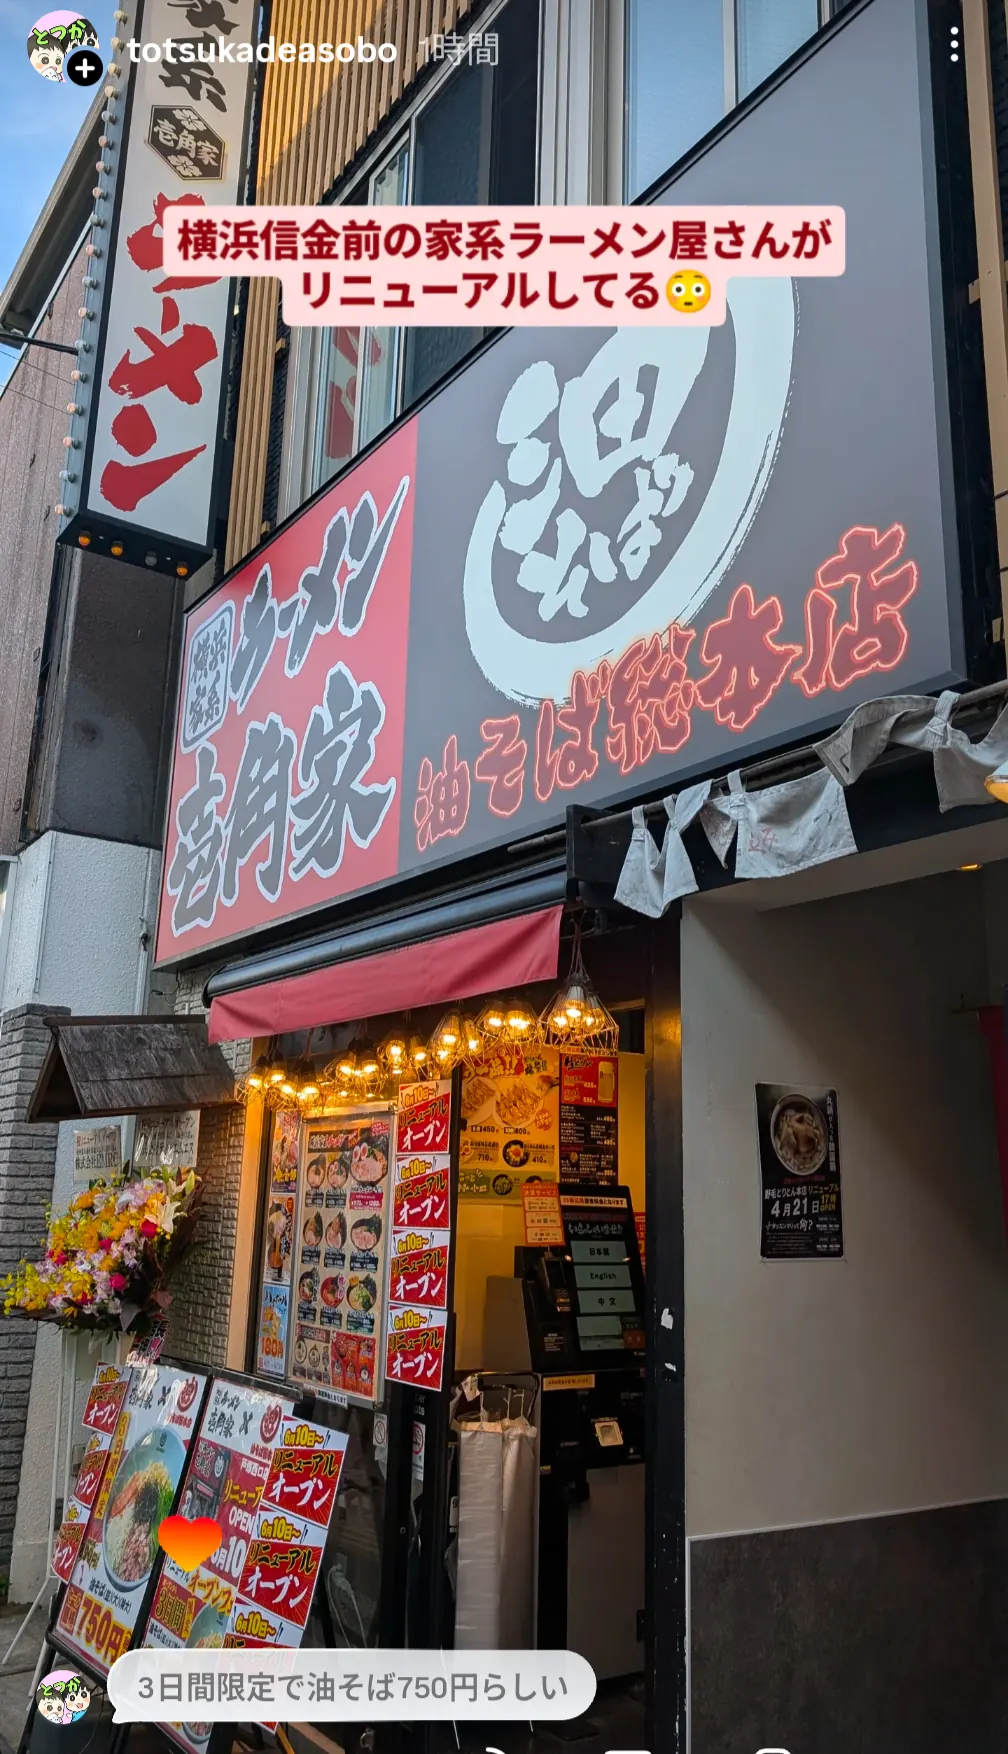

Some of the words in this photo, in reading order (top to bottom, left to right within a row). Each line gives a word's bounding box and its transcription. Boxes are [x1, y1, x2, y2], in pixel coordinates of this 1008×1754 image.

[153, 118, 220, 167] 壱角家
[229, 475, 411, 714] ラーメン
[413, 522, 919, 852] 油そば総本店
[167, 660, 396, 938] 壱角家
[399, 1098, 449, 1127] リニューアル
[402, 1119, 447, 1150] オープン
[395, 1171, 447, 1201] リニューアル
[398, 1195, 446, 1225] オープン
[770, 1197, 820, 1218] 4月21日
[392, 1249, 445, 1277] リニューアル
[589, 1272, 617, 1281] English
[395, 1272, 443, 1300] オープン
[597, 1297, 617, 1306] 中文
[388, 1327, 442, 1351] リニューアル
[391, 1351, 439, 1378] オープン
[273, 1449, 338, 1477] リニューアル
[268, 1472, 332, 1510] オープン
[228, 1505, 255, 1535] OPEN
[250, 1541, 316, 1575] リニューアル
[245, 1566, 309, 1609] オープン
[75, 1596, 125, 1664] 750円
